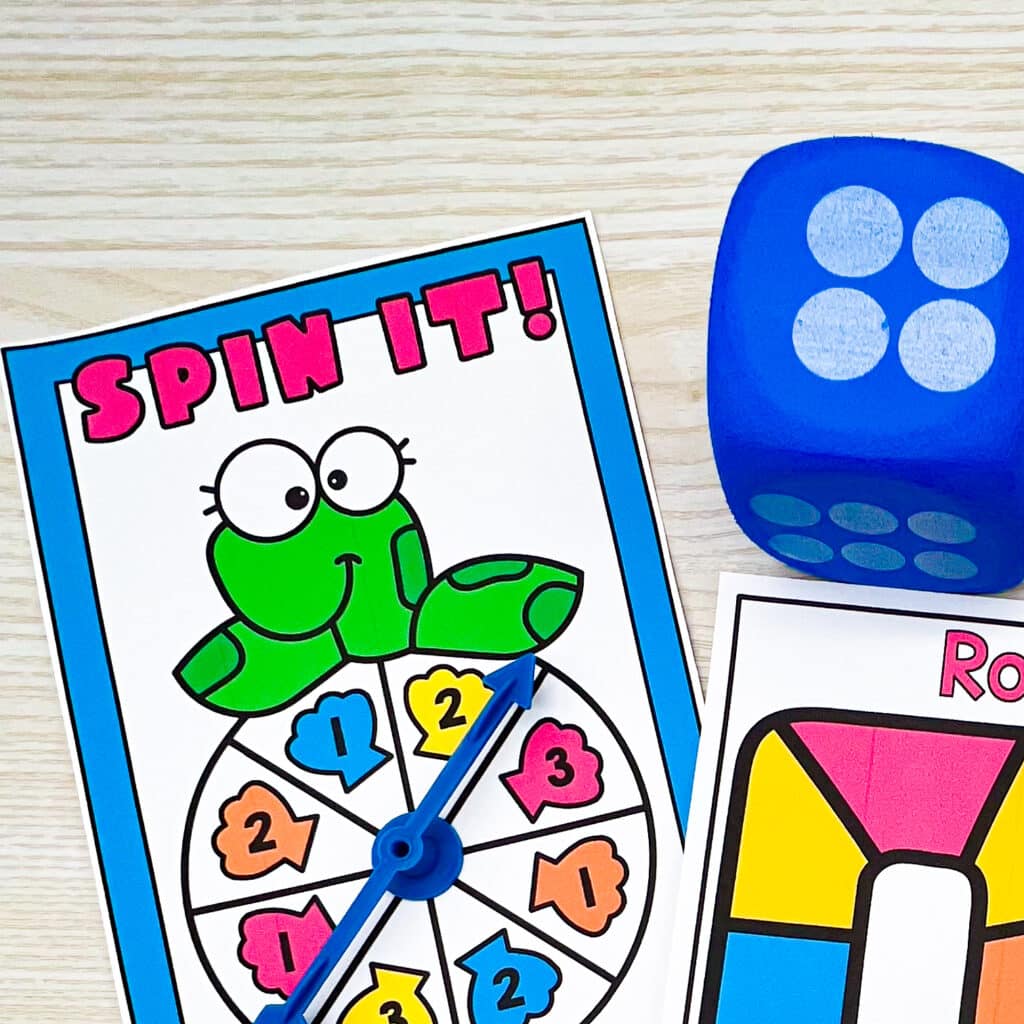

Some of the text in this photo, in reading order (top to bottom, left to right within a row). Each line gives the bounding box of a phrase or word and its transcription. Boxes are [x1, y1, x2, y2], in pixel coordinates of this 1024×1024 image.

[73, 257, 557, 443] SPIN IT!
[435, 687, 467, 729] 2
[329, 716, 347, 757] 1
[545, 748, 575, 788] 3
[243, 811, 276, 854] 2
[578, 866, 597, 908] 1
[276, 931, 295, 973] 1
[493, 967, 525, 1011] 2
